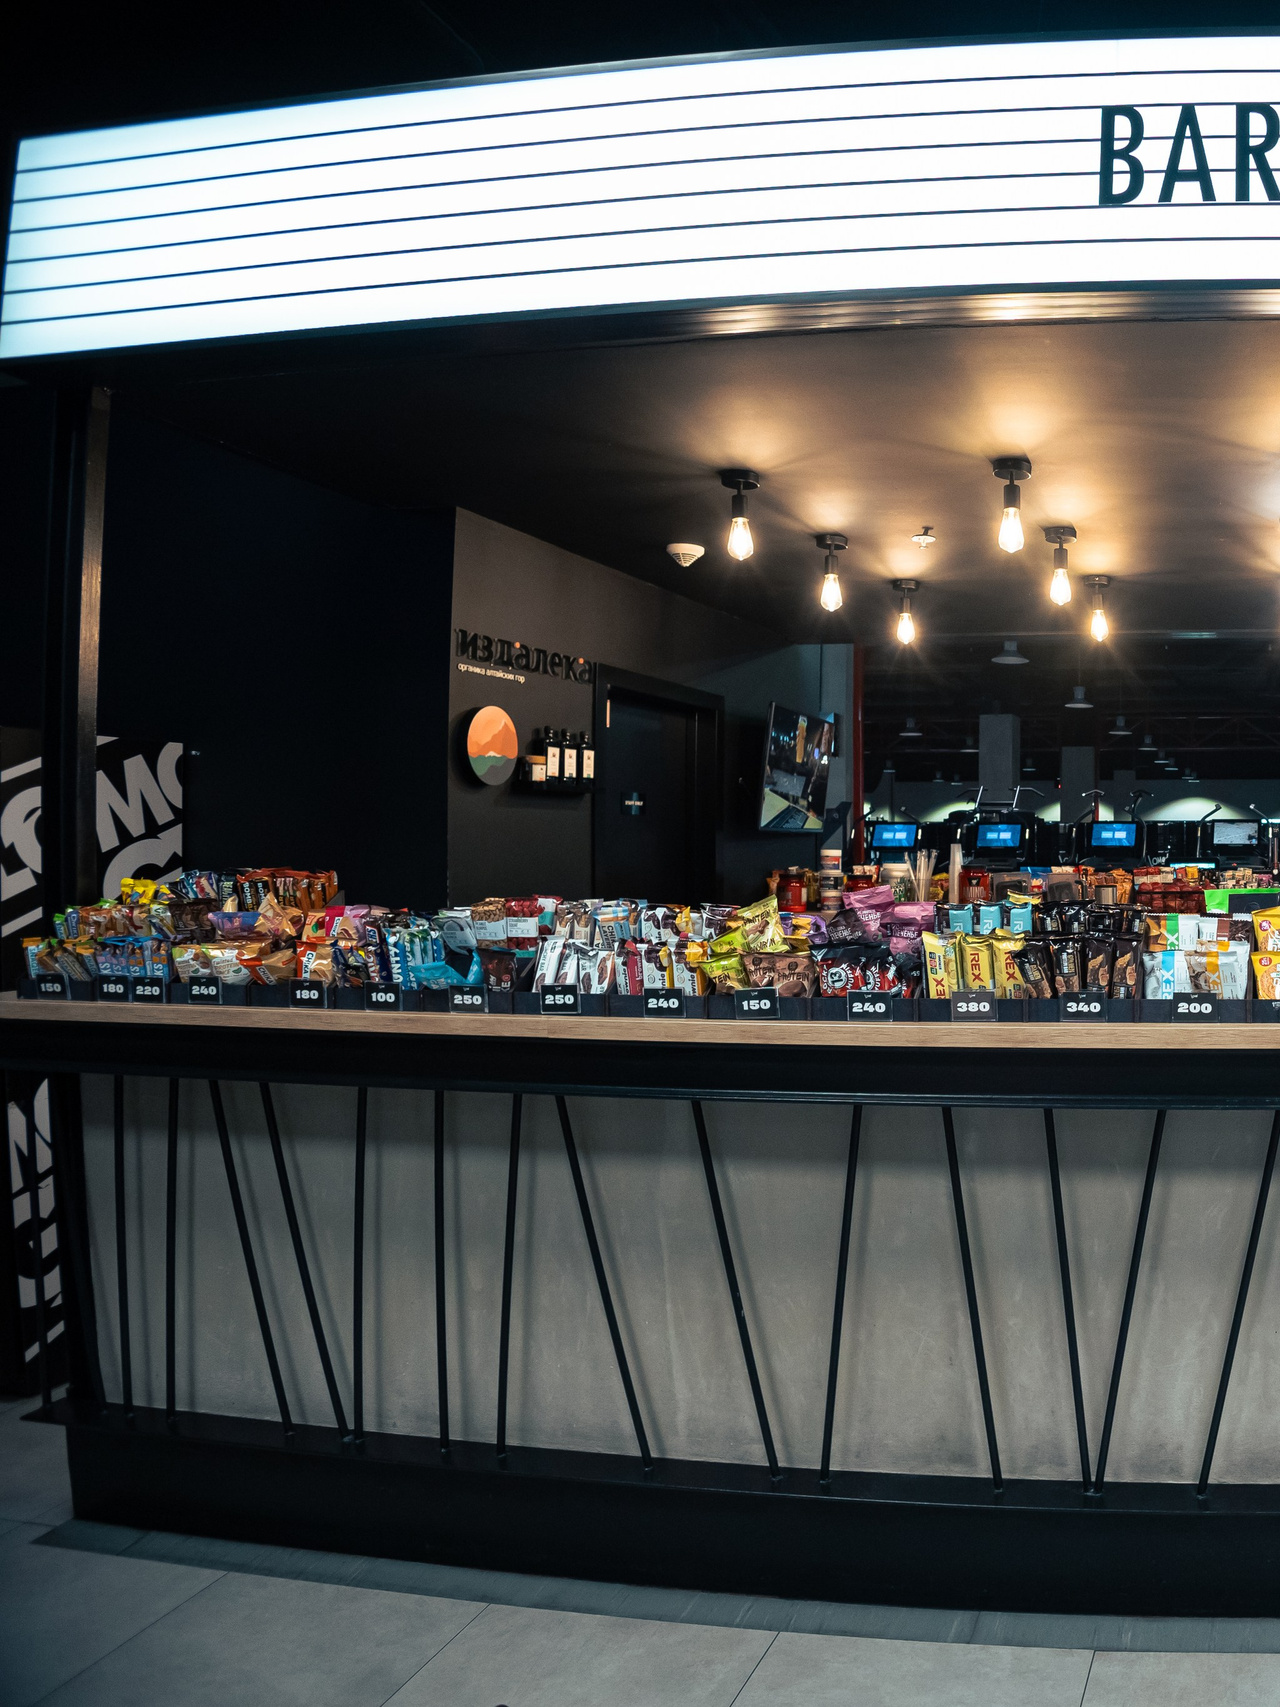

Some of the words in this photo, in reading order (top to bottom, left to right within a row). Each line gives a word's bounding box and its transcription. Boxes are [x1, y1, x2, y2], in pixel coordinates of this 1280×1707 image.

[455, 628, 595, 684] издалека
[515, 675, 526, 684] гор
[389, 946, 404, 983] UNTY
[969, 952, 984, 983] REX
[1004, 951, 1018, 982] REX
[713, 973, 731, 986] TEIN
[1209, 971, 1222, 995] EX
[40, 983, 62, 993] 150
[102, 984, 124, 993] 180
[135, 986, 160, 995] 220
[191, 985, 217, 995] 240
[295, 989, 319, 1000] 180
[371, 992, 396, 1003] 100
[453, 994, 482, 1005] 250
[544, 994, 575, 1005] 250
[647, 998, 679, 1008] 240
[742, 999, 771, 1011] 150
[852, 1002, 886, 1013] 240
[956, 1002, 990, 1013] 380
[1066, 1002, 1101, 1013] 340
[1177, 1002, 1213, 1014] 200
